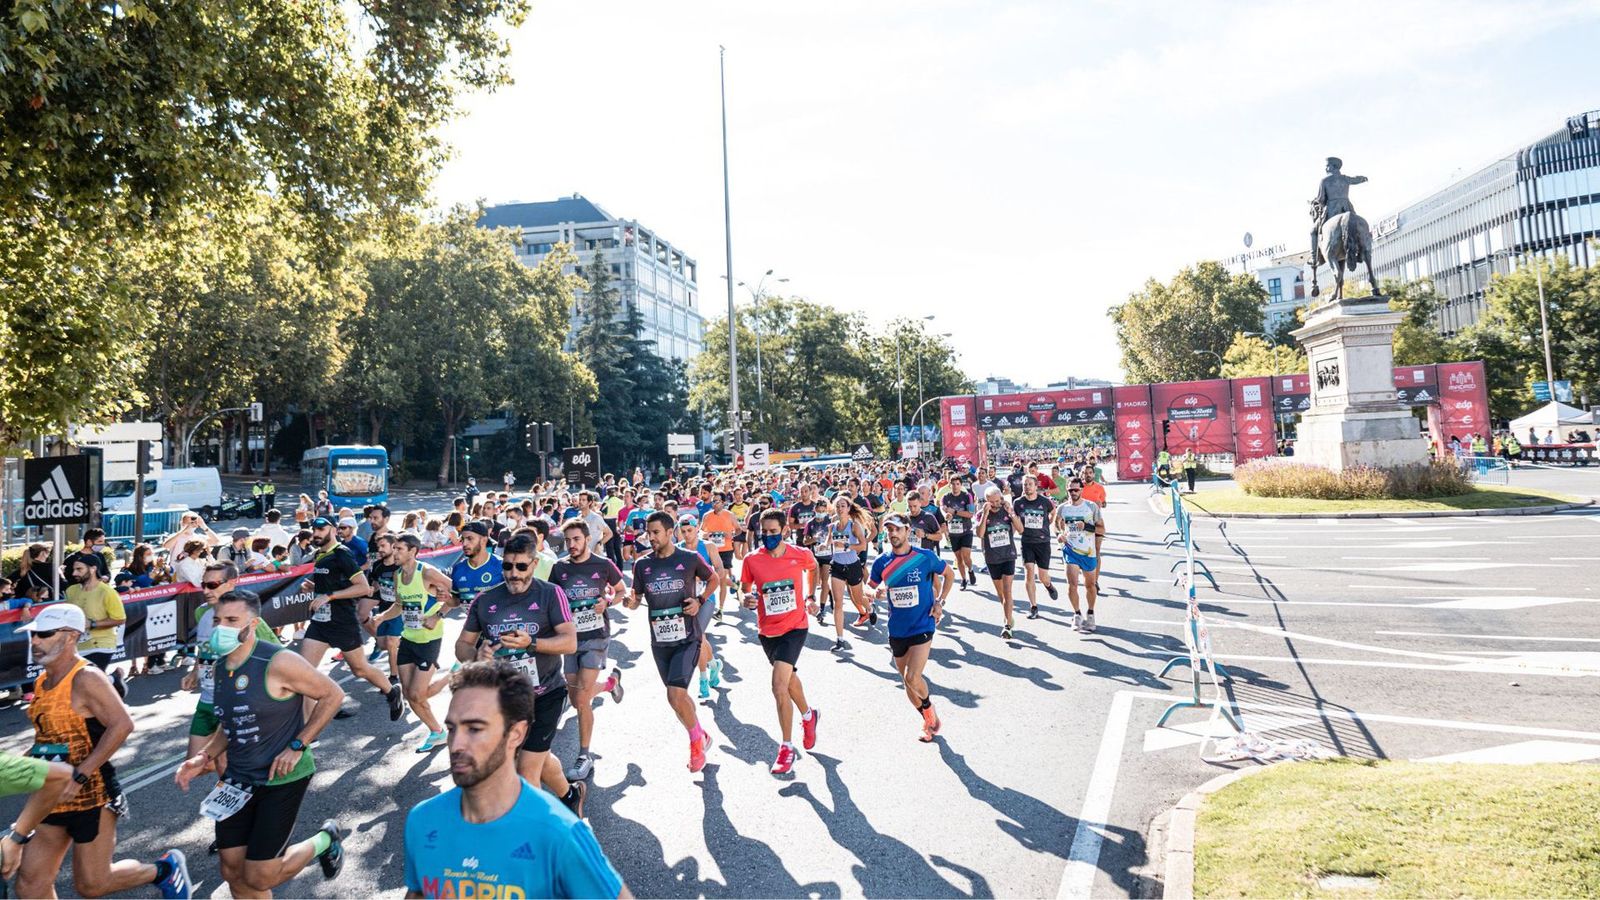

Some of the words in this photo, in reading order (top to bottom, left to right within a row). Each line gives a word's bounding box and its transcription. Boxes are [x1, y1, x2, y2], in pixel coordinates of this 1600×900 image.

[1184, 396, 1198, 406] edp
[1456, 400, 1472, 410] edp
[1015, 414, 1029, 424] edp
[1058, 411, 1072, 422] edp
[1246, 412, 1262, 421] edp
[1127, 420, 1141, 429] edp
[953, 430, 967, 438] edp
[572, 451, 591, 467] edp
[25, 499, 84, 519] adidas
[646, 579, 684, 593] MADRID
[131, 589, 162, 599] MARATÓN
[285, 592, 314, 605] MADRI
[895, 592, 913, 601] 20968
[770, 596, 790, 606] 20763
[577, 613, 597, 624] 20565
[659, 624, 679, 634] 20512
[147, 634, 177, 646] Comunidad
[157, 641, 177, 650] Madrid
[213, 791, 240, 809] 20901
[462, 856, 479, 870] edp
[422, 876, 526, 899] MADRID
